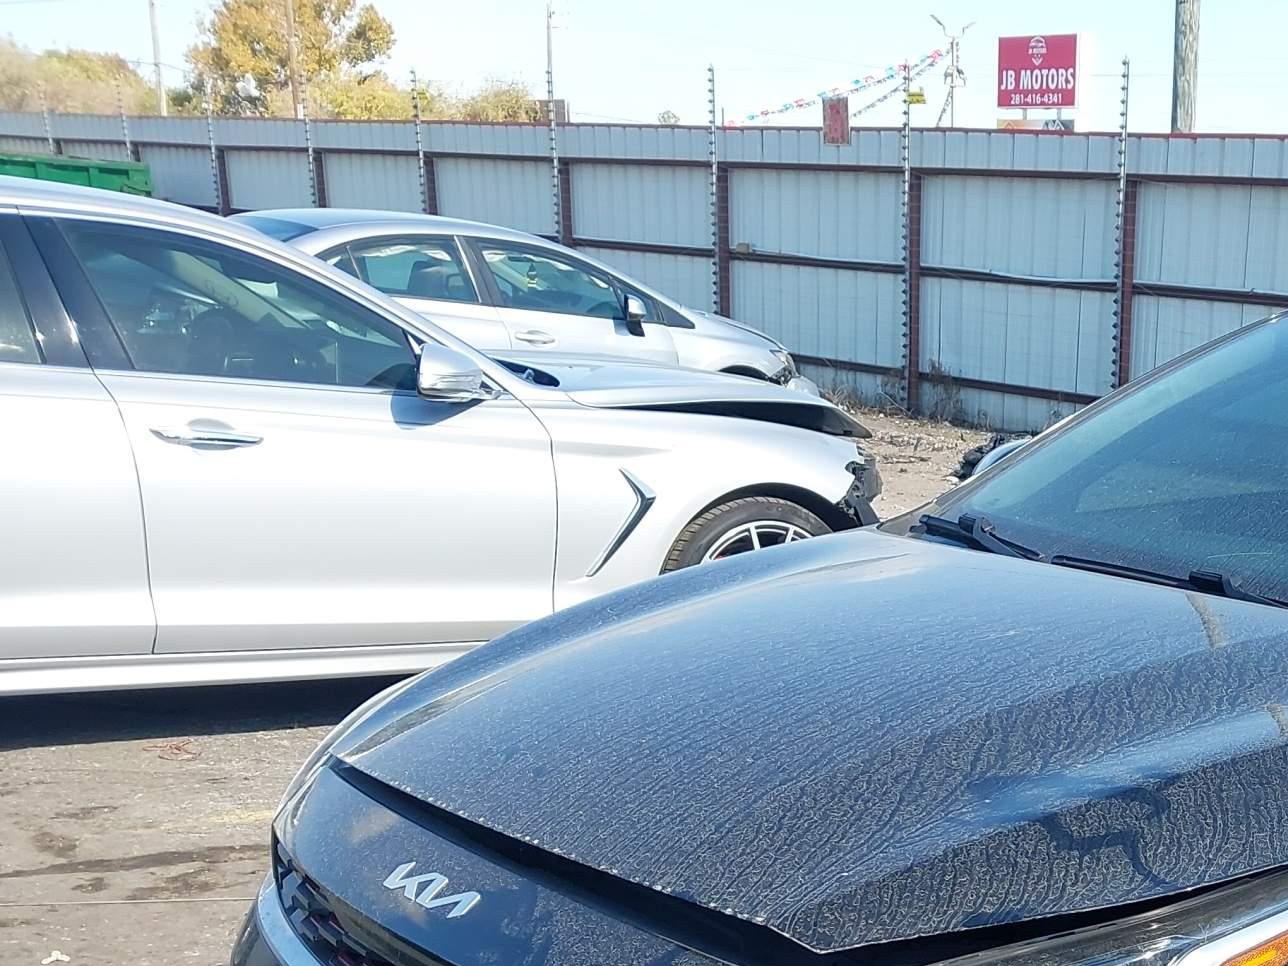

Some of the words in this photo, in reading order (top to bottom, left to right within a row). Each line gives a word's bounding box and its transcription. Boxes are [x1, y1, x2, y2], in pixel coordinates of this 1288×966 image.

[1001, 69, 1016, 90] JB
[1019, 67, 1075, 90] MOTORS
[1010, 92, 1062, 105] 281-416-4341
[383, 861, 481, 919] KIA
